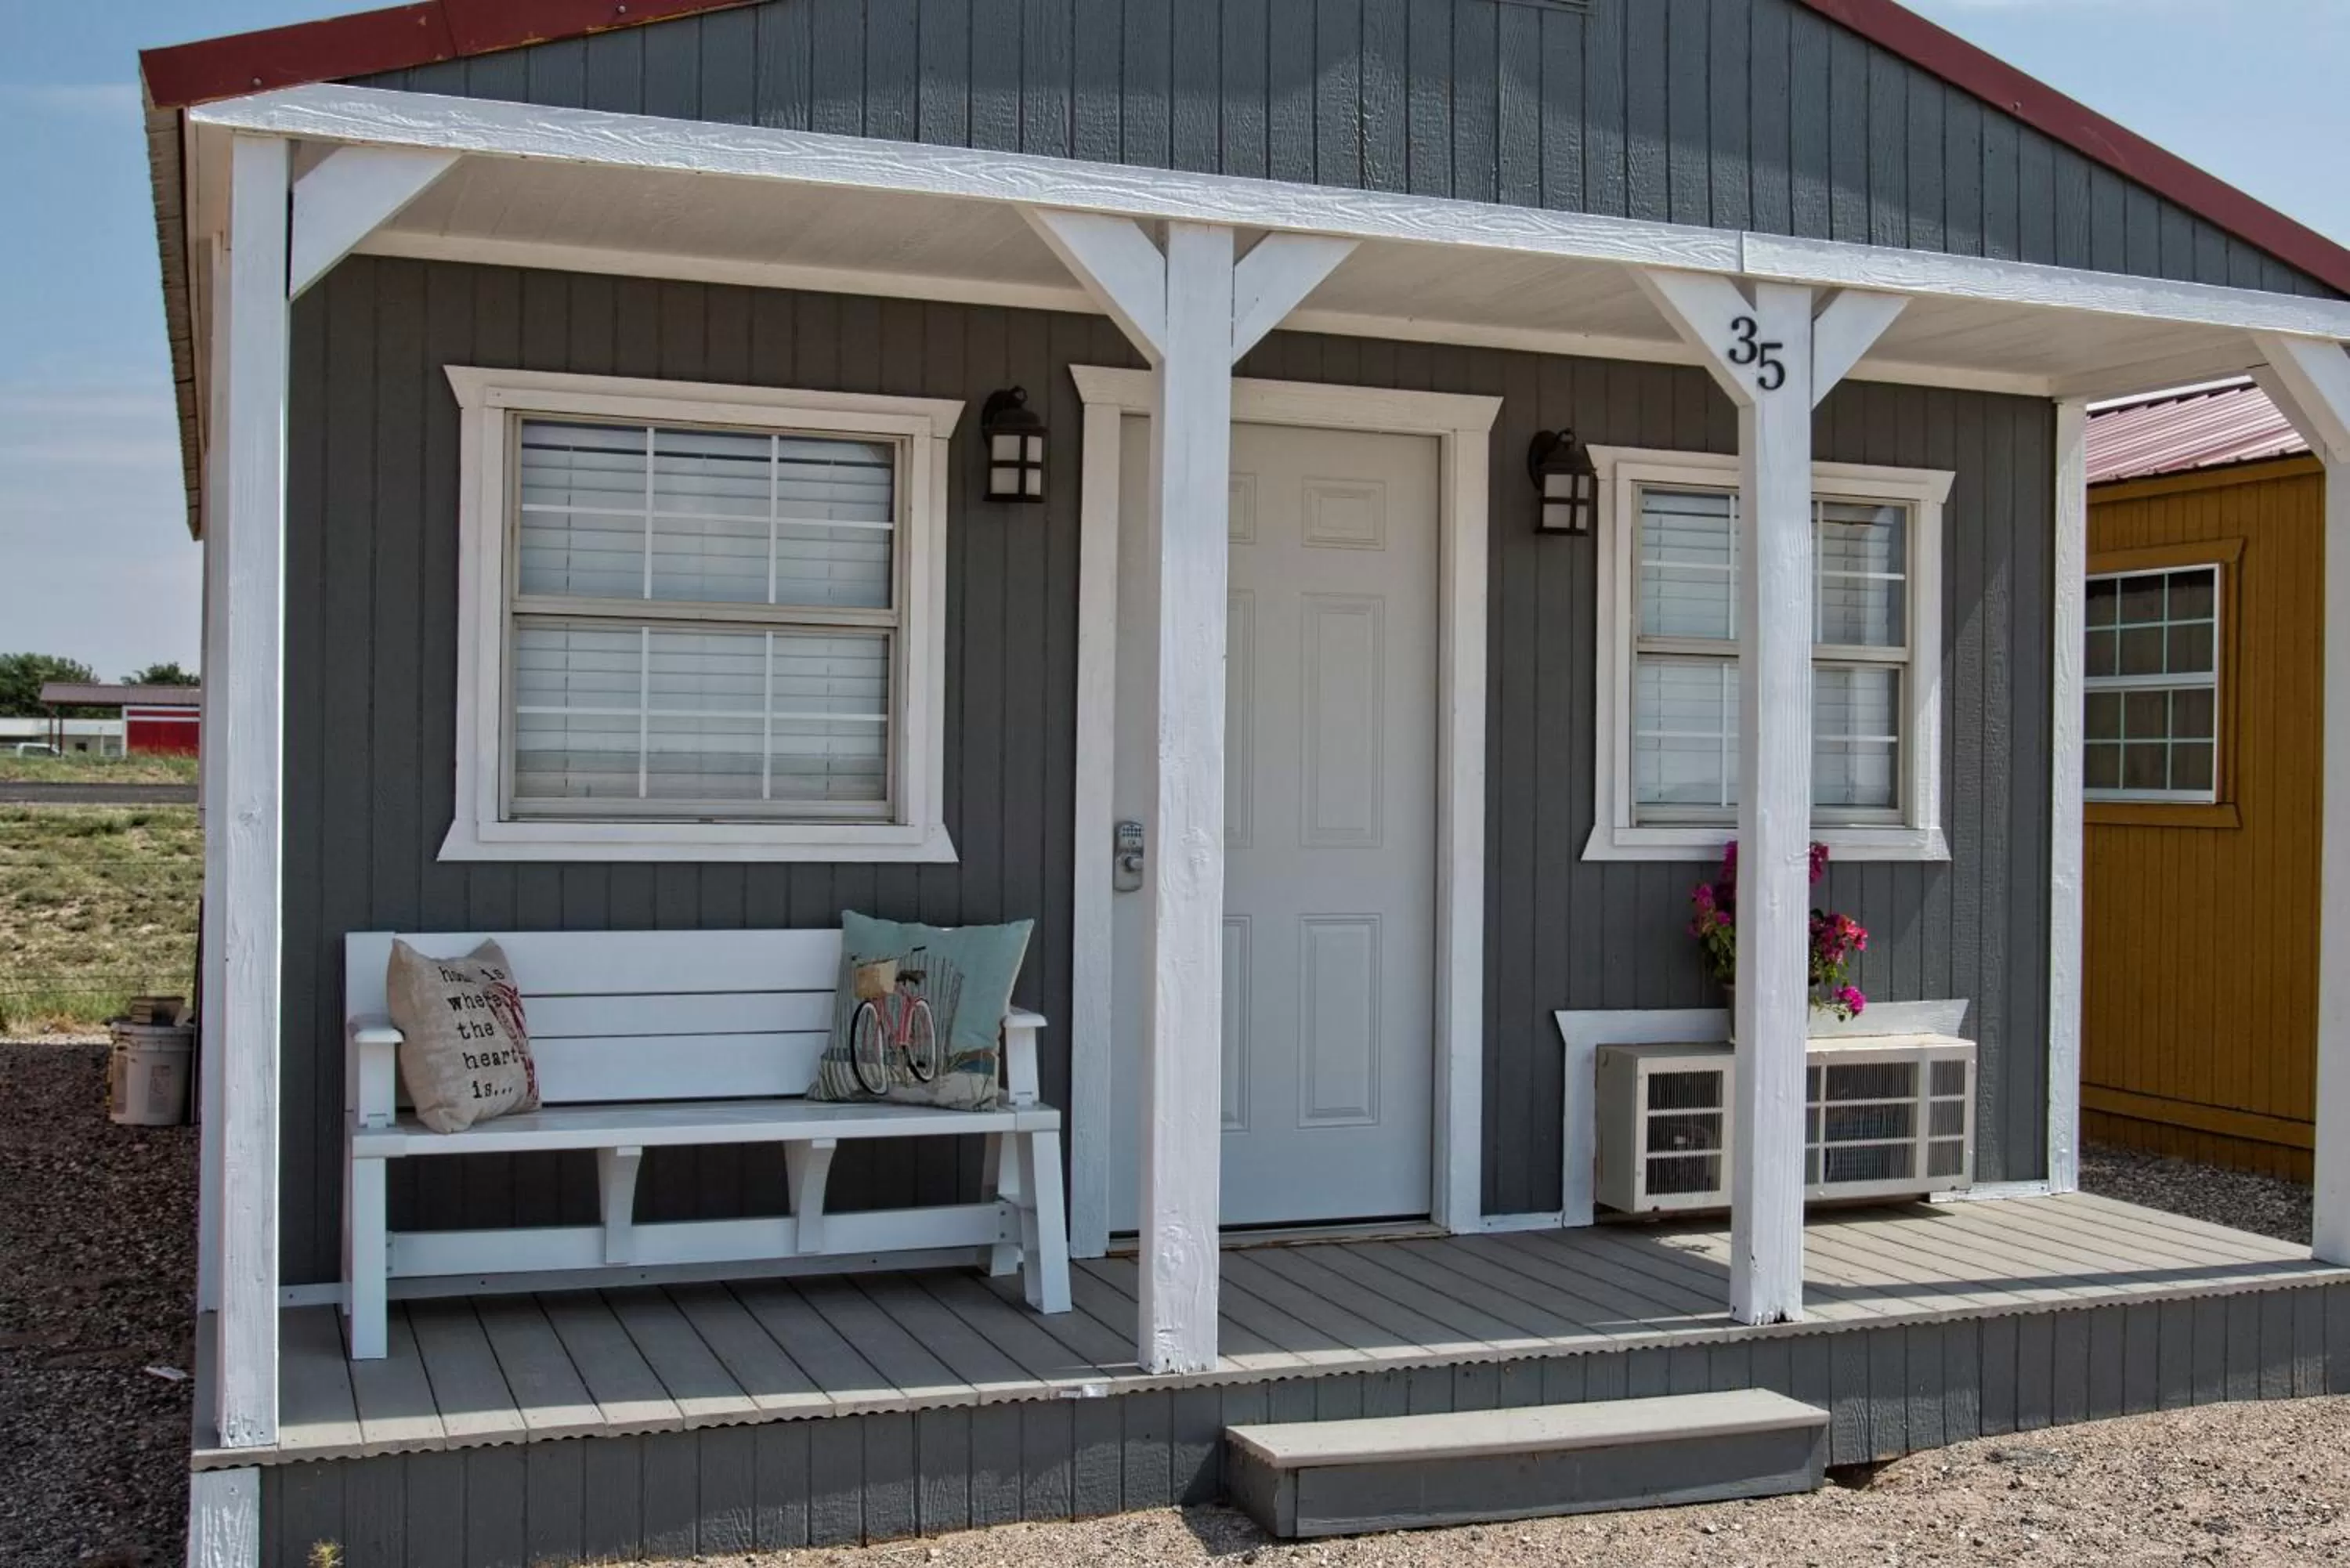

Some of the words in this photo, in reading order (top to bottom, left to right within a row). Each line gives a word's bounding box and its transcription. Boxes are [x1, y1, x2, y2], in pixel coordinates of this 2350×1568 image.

[1728, 316, 1785, 390] 35
[446, 992, 503, 1011] where
[457, 1021, 494, 1039] the
[462, 1046, 519, 1069] heart
[472, 1081, 513, 1098] is...
